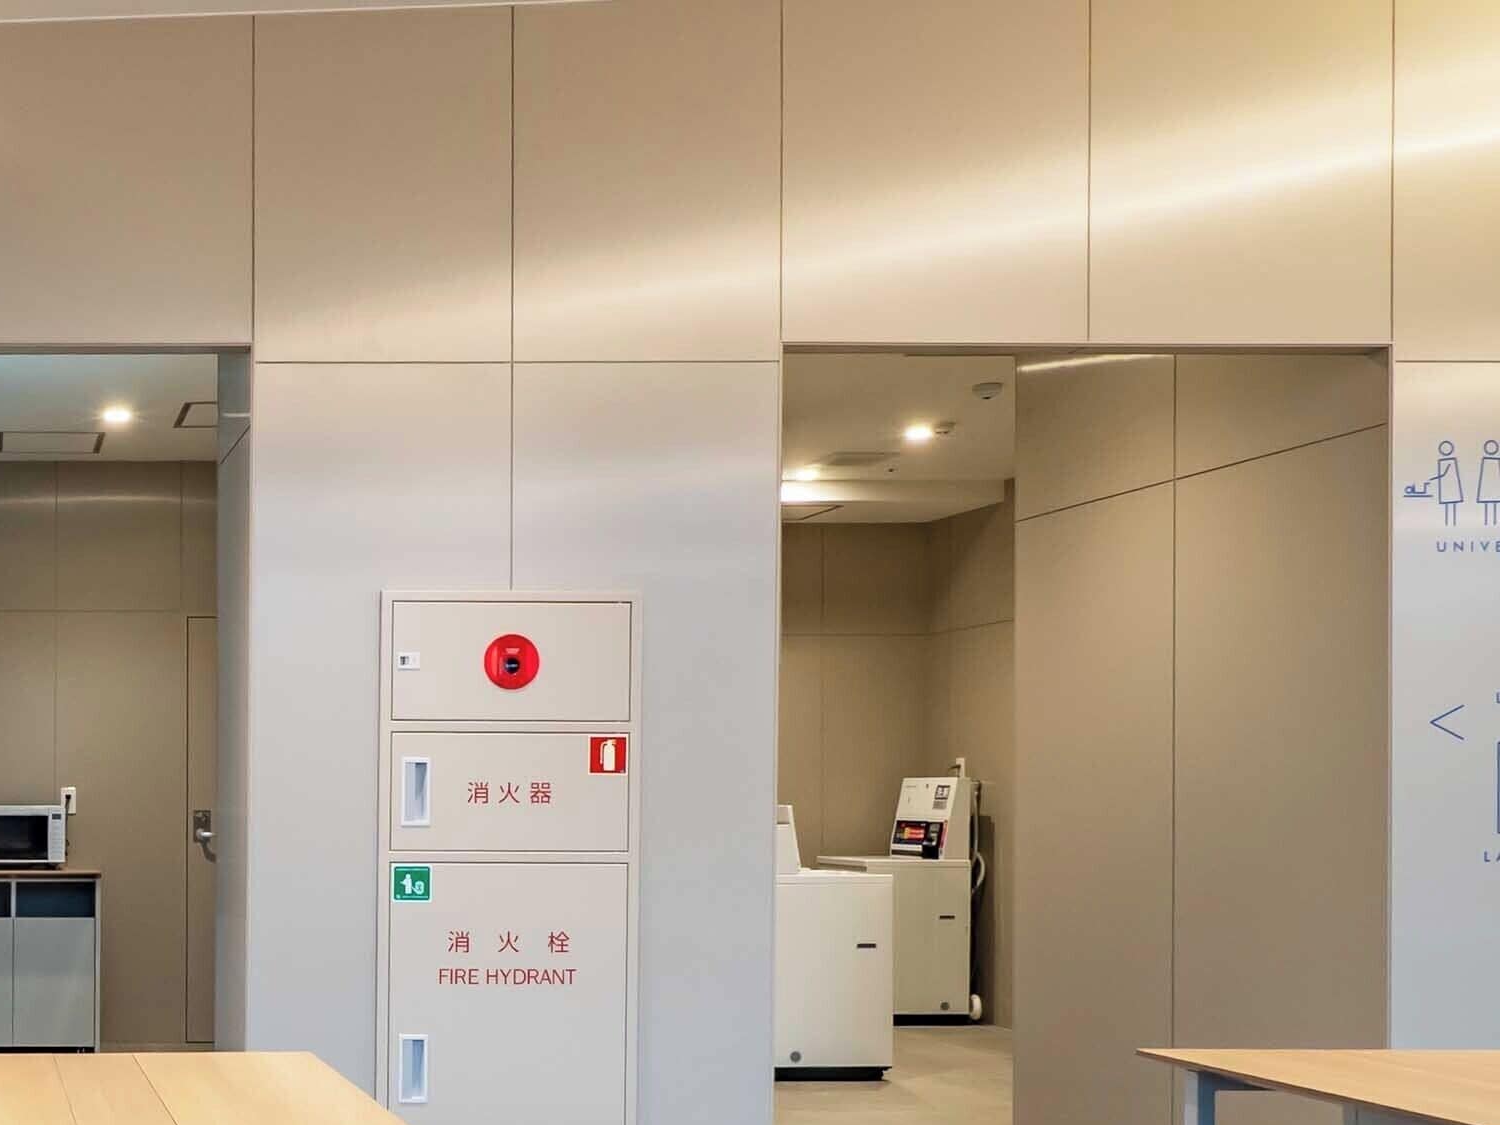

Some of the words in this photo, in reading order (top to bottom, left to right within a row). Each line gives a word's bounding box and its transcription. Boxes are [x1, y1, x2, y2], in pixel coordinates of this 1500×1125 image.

[467, 782, 552, 804] 消火器
[438, 968, 480, 985] FIRE
[486, 968, 577, 985] HYDRANT
